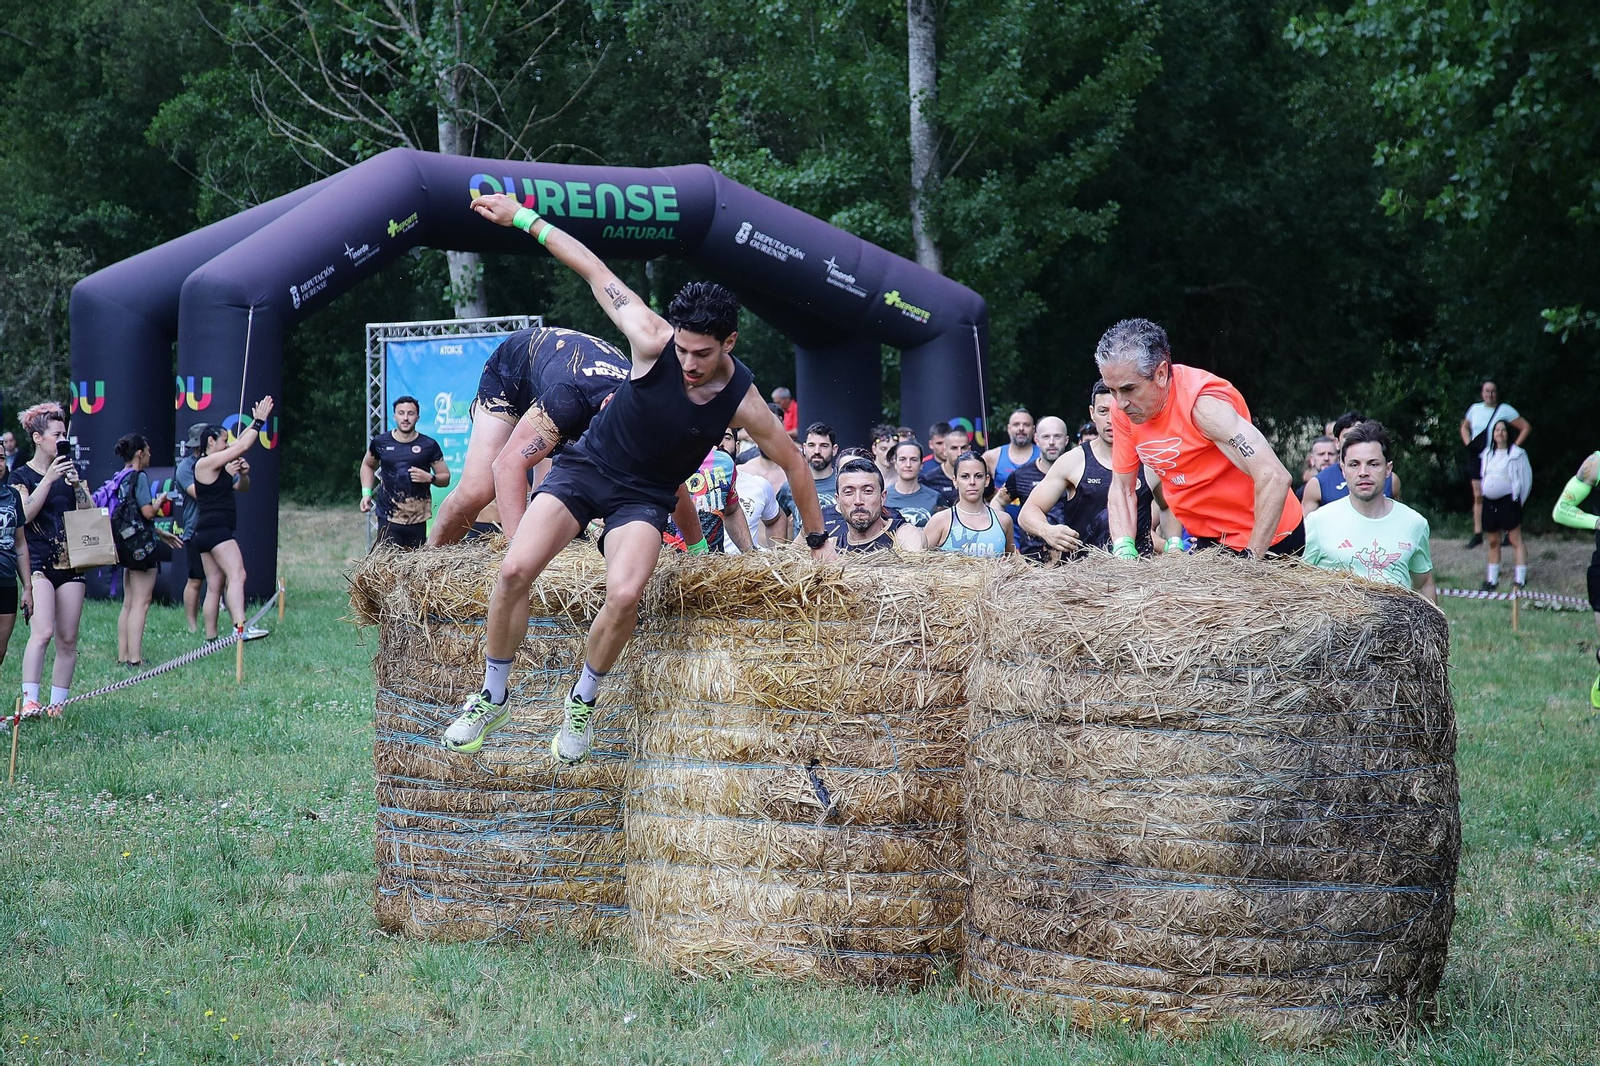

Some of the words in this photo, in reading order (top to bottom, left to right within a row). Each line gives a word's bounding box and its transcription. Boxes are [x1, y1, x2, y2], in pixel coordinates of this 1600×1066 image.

[469, 173, 680, 221] OURENSE
[602, 225, 676, 240] NATURAL
[749, 238, 789, 262] OURENSE
[753, 230, 806, 261] DEPUTACIÓN
[300, 264, 335, 293] DEPUTACIÓN
[301, 279, 328, 302] OURENSE
[603, 282, 621, 300] 34
[521, 444, 538, 459] 32
[1239, 441, 1255, 458] 45
